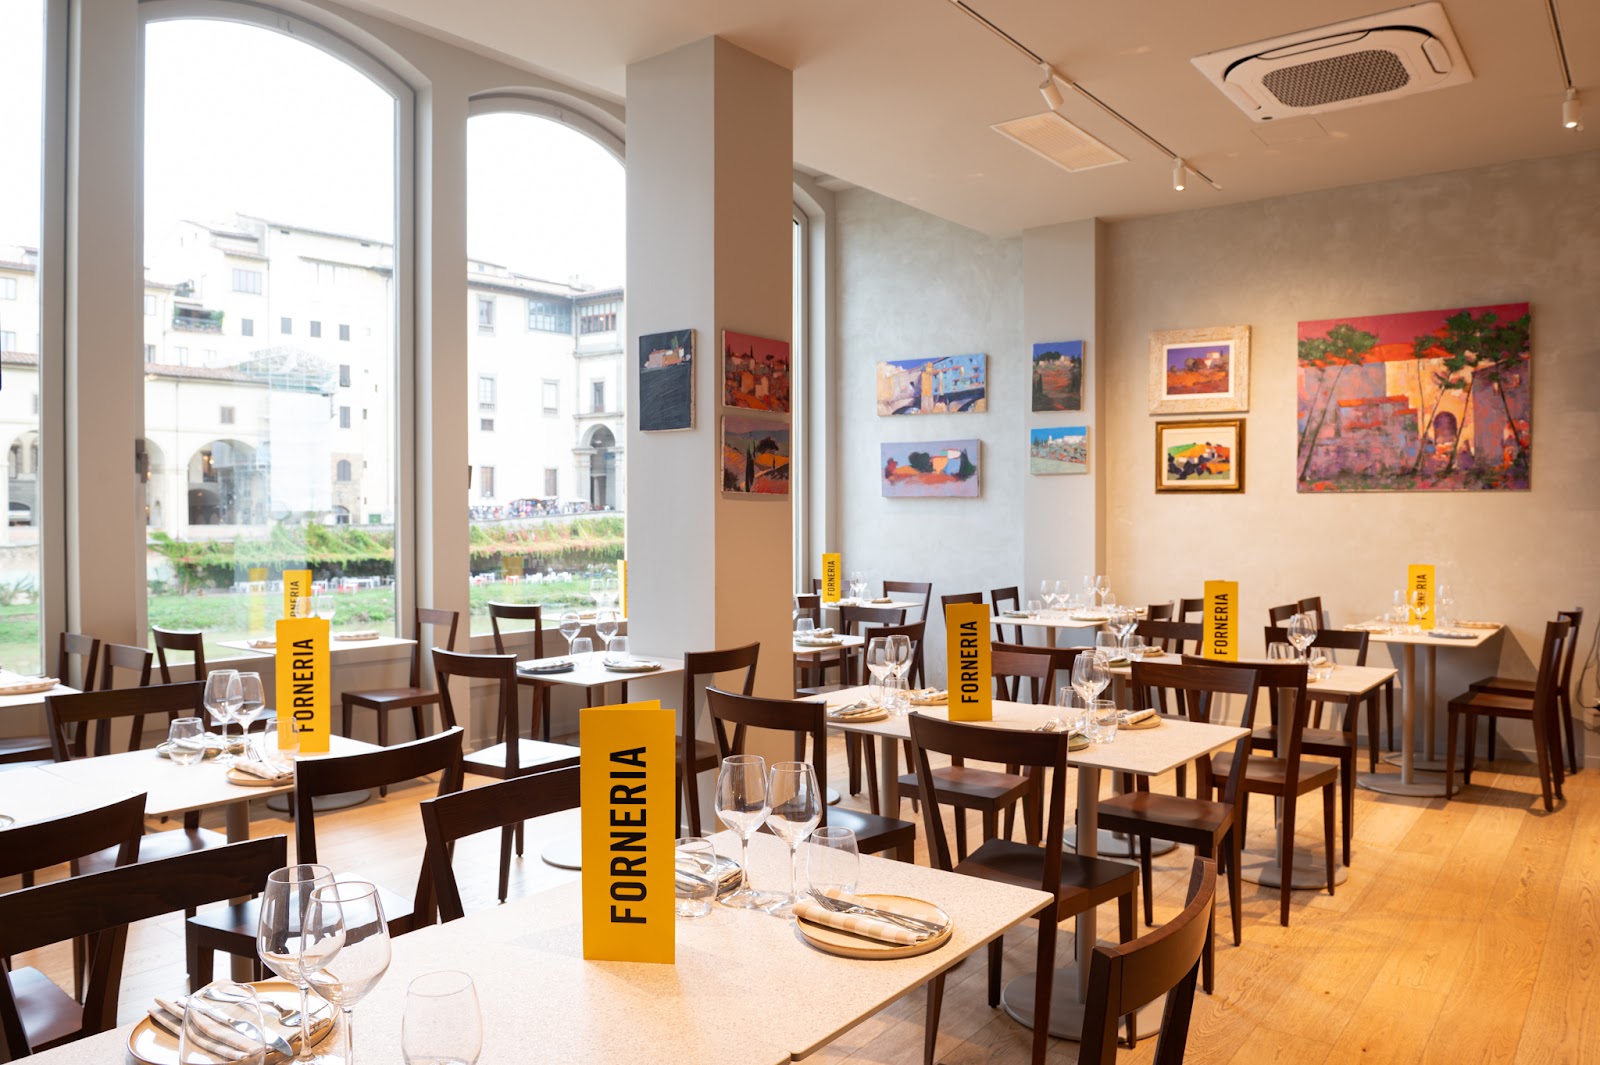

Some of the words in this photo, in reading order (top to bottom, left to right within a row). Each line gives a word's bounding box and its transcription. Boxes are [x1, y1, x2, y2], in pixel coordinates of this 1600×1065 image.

[827, 560, 836, 597] FORNERIA
[960, 621, 979, 704] FORNERIA
[1214, 593, 1229, 655] FORNERIA
[292, 638, 315, 733] FORNERIA
[609, 746, 648, 924] FORNERIA
